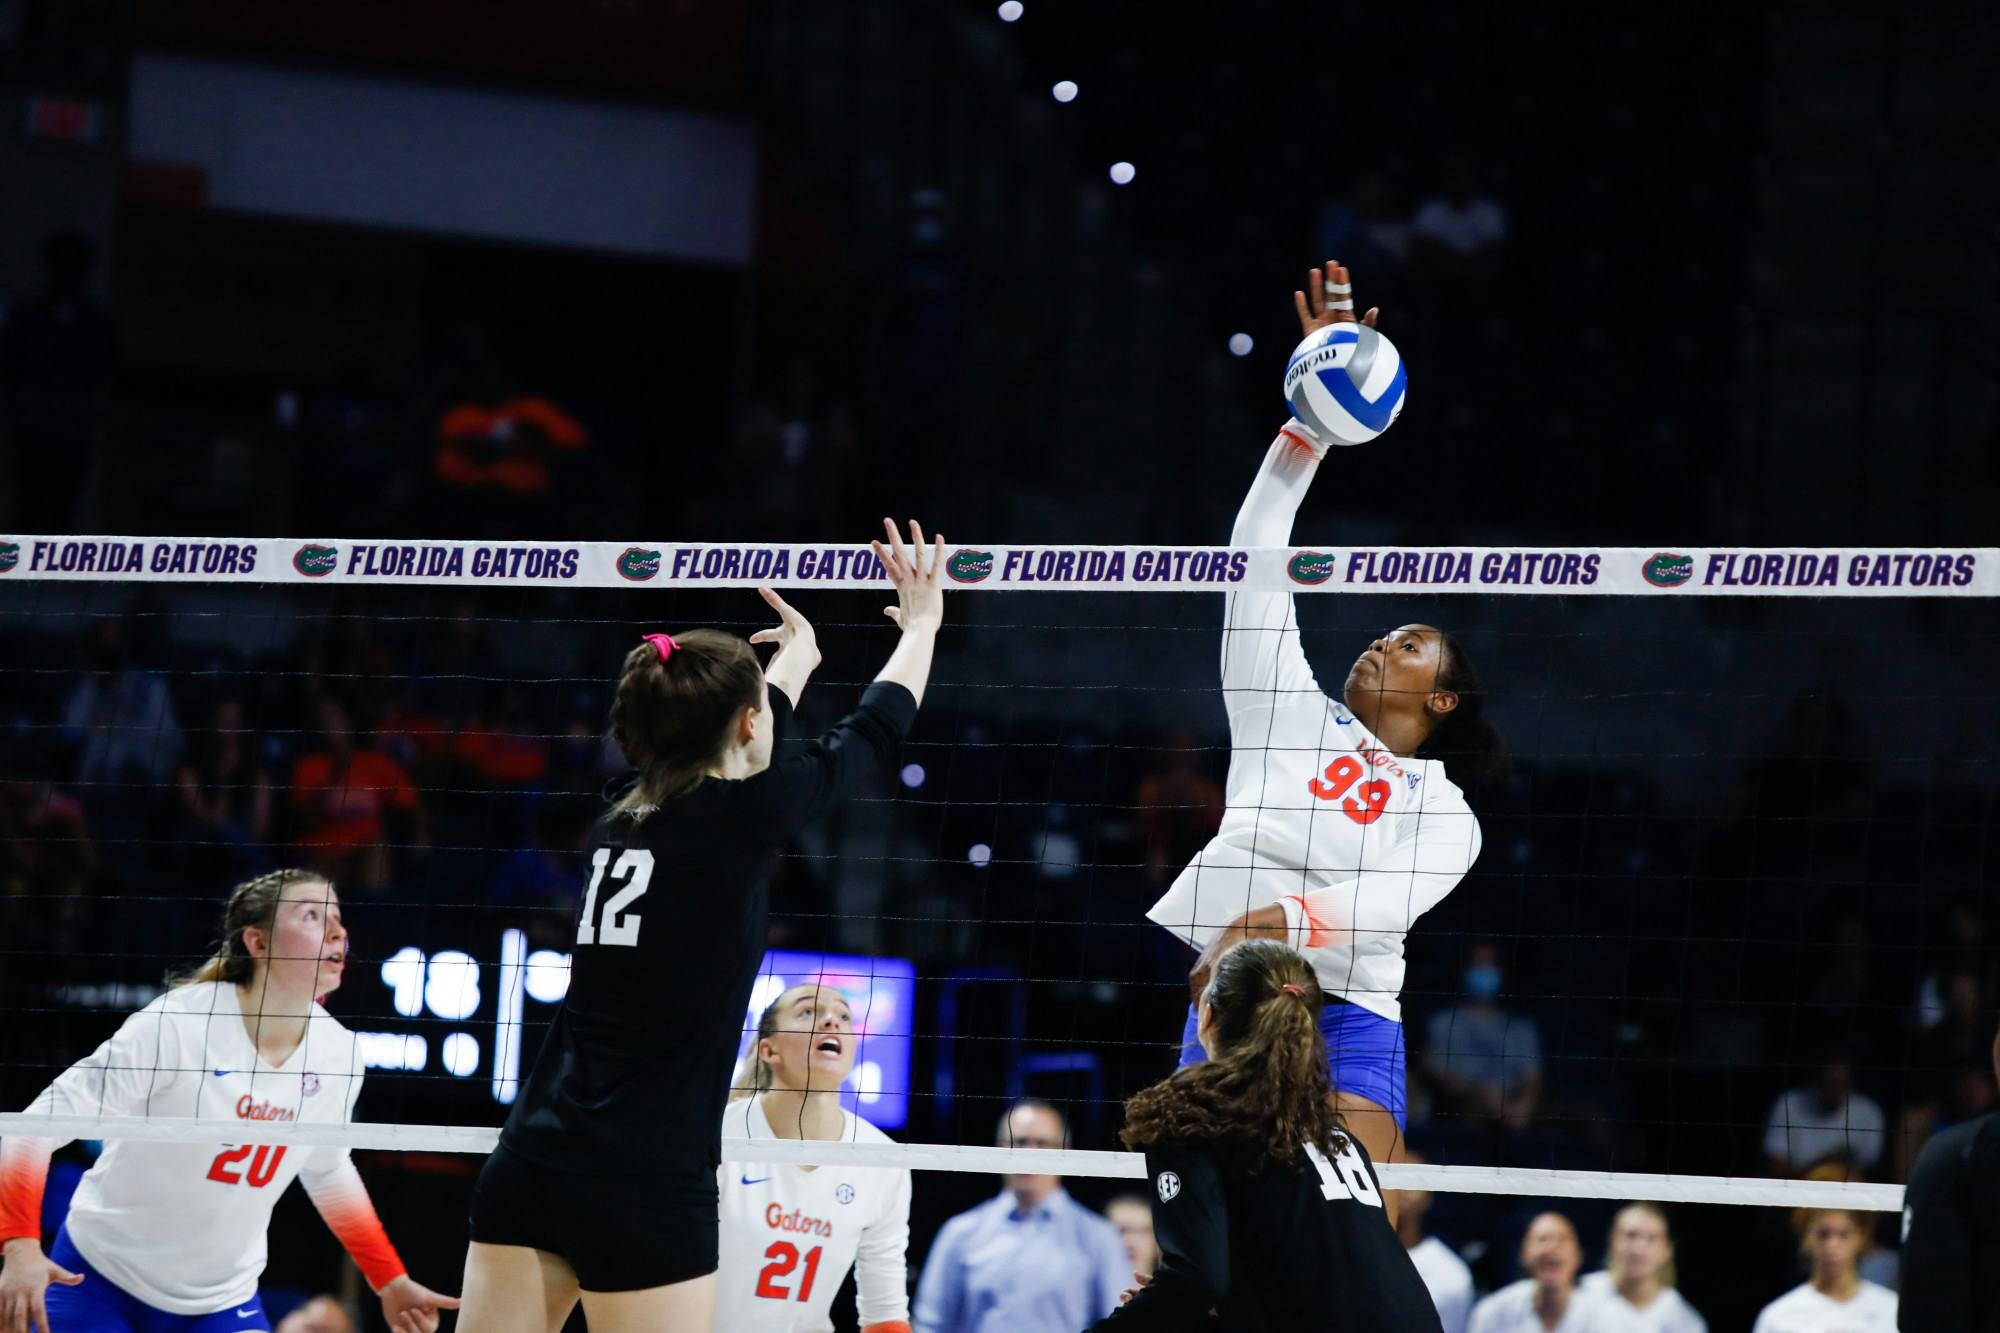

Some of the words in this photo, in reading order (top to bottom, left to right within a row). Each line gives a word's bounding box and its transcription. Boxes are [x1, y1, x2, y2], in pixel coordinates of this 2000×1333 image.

[1286, 348, 1338, 387] molten
[31, 541, 144, 573] FLORIDA
[151, 543, 257, 574] GATORS
[347, 546, 464, 577] FLORIDA
[471, 547, 579, 579] GATORS
[671, 548, 790, 580] FLORIDA
[796, 549, 893, 581] GATOR
[1001, 550, 1125, 582] FLORIDA
[1132, 550, 1248, 583] GATORS
[1346, 551, 1472, 584] FLORIDA
[1480, 552, 1601, 586] GATORS
[1704, 553, 1839, 587] FLORIDA
[1847, 554, 1975, 587] GATORS
[1308, 755, 1392, 825] 99
[577, 848, 655, 946] 12
[206, 1143, 288, 1188] 20
[1302, 1127, 1383, 1208] 18
[765, 1202, 832, 1237] Gators
[755, 1240, 823, 1302] 21
